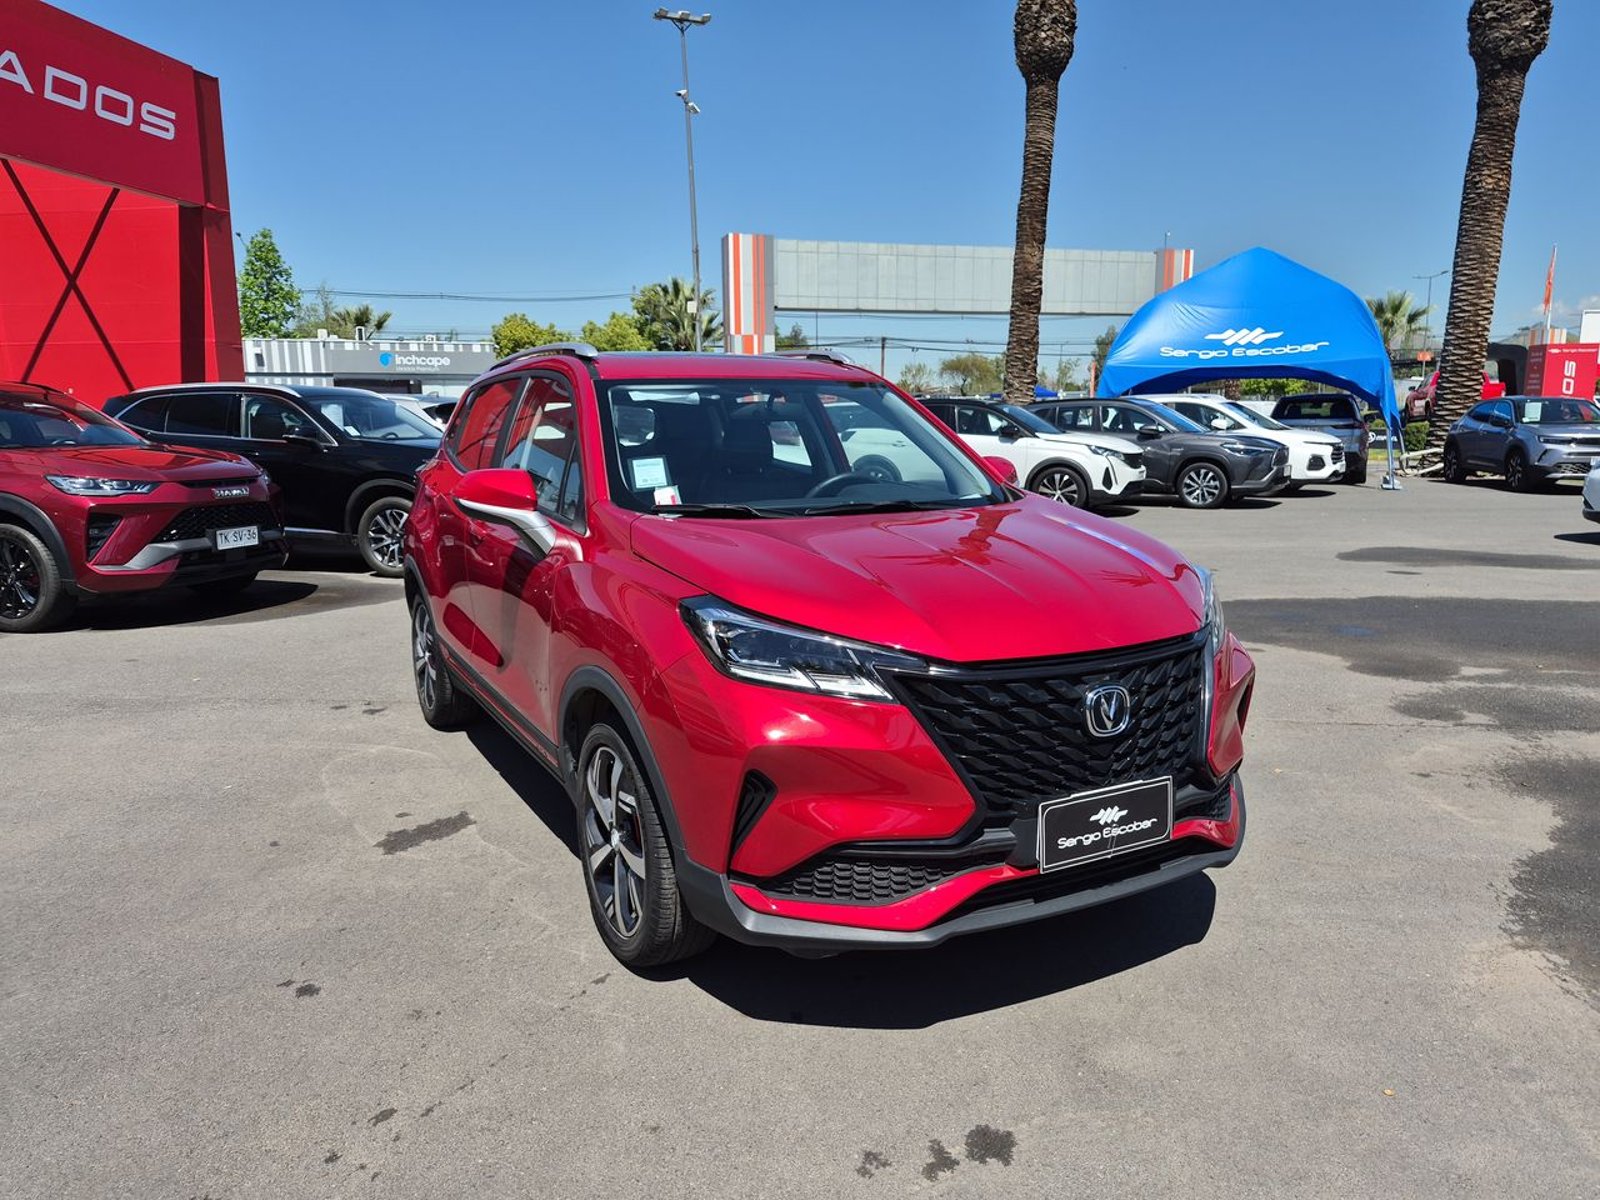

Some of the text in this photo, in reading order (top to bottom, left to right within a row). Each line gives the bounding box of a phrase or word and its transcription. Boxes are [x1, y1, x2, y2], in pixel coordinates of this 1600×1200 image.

[0, 50, 176, 141] ADOS
[1159, 341, 1330, 360] Sergio Escobar
[1057, 818, 1157, 849] Sergio Escobar
